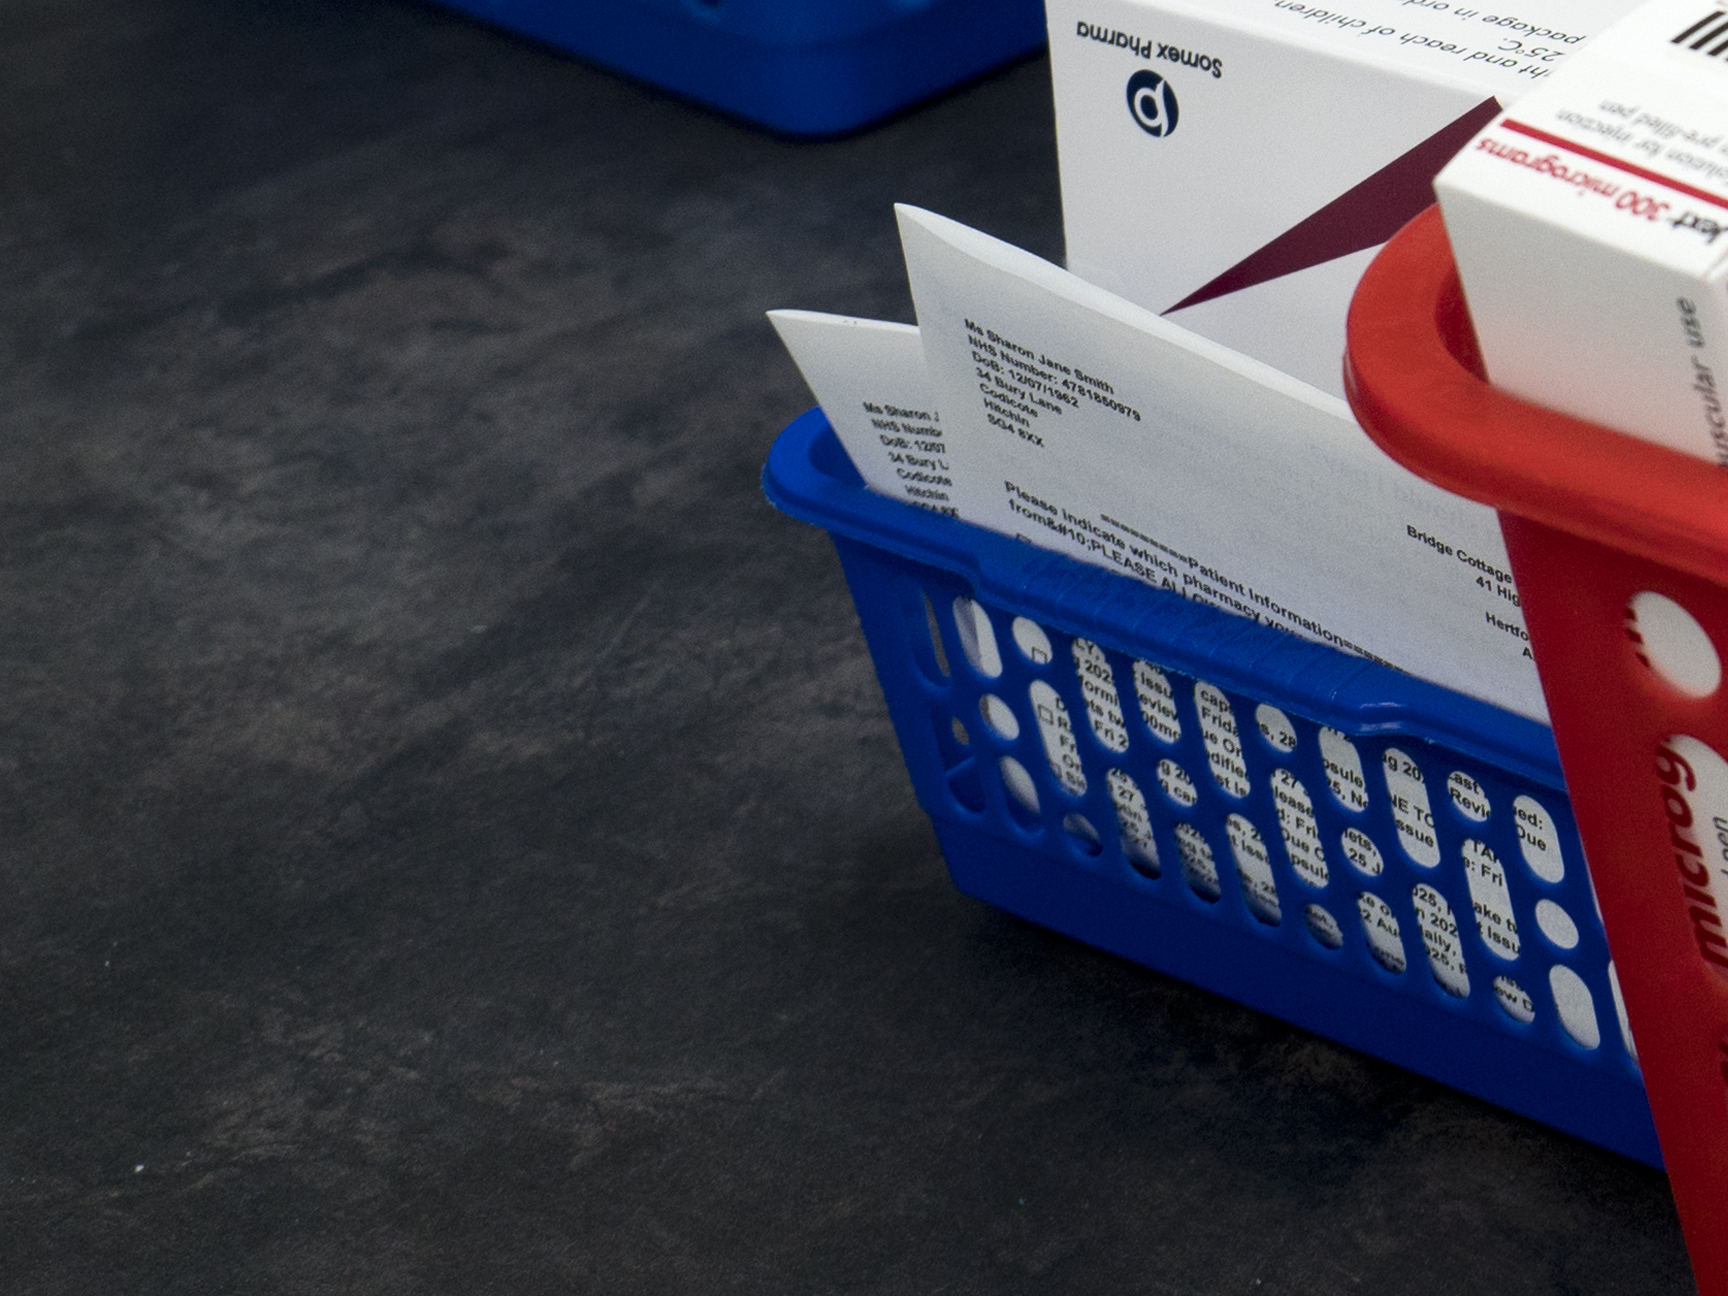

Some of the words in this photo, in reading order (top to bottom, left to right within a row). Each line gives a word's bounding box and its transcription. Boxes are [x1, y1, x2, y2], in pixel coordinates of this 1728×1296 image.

[1358, 23, 1397, 37] of
[1451, 5, 1480, 22] in
[1479, 13, 1588, 45] package
[1074, 18, 1153, 61] Pharma
[1397, 31, 1469, 56] reach
[1154, 40, 1224, 80] Somex
[1473, 135, 1621, 199] micrograms
[1612, 188, 1671, 222] 300
[962, 316, 986, 338] Ms
[984, 327, 1036, 362] Sharon
[1036, 352, 1073, 377] Jane
[1071, 366, 1116, 397] Smith
[1404, 522, 1455, 558] Bridge
[1454, 547, 1514, 586] Cottage
